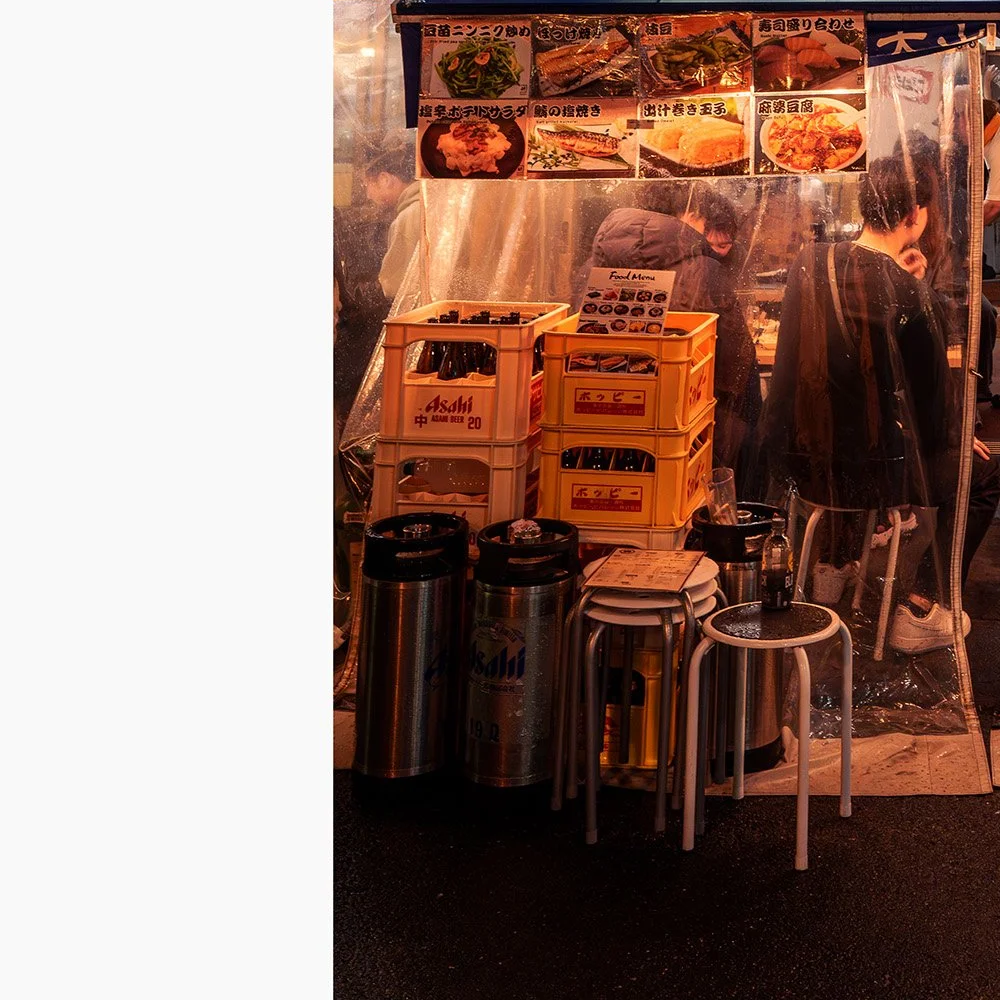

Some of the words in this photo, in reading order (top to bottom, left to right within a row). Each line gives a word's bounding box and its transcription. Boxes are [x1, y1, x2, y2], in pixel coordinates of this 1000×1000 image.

[423, 24, 530, 38] 豆苗ニンニク炒め
[645, 22, 673, 36] 枝豆
[758, 17, 855, 32] 寿司盛り合わせ
[419, 105, 528, 119] 塩辛ポテトサラダ
[533, 105, 601, 118] 鯖の塩焼き
[643, 102, 727, 117] 出汁巻き玉子
[758, 100, 814, 114] 麻婆豆腐
[608, 270, 631, 281] Food
[631, 272, 656, 282] Menu
[425, 394, 473, 414] Asahi
[414, 414, 428, 428] 中
[467, 416, 482, 430] 20
